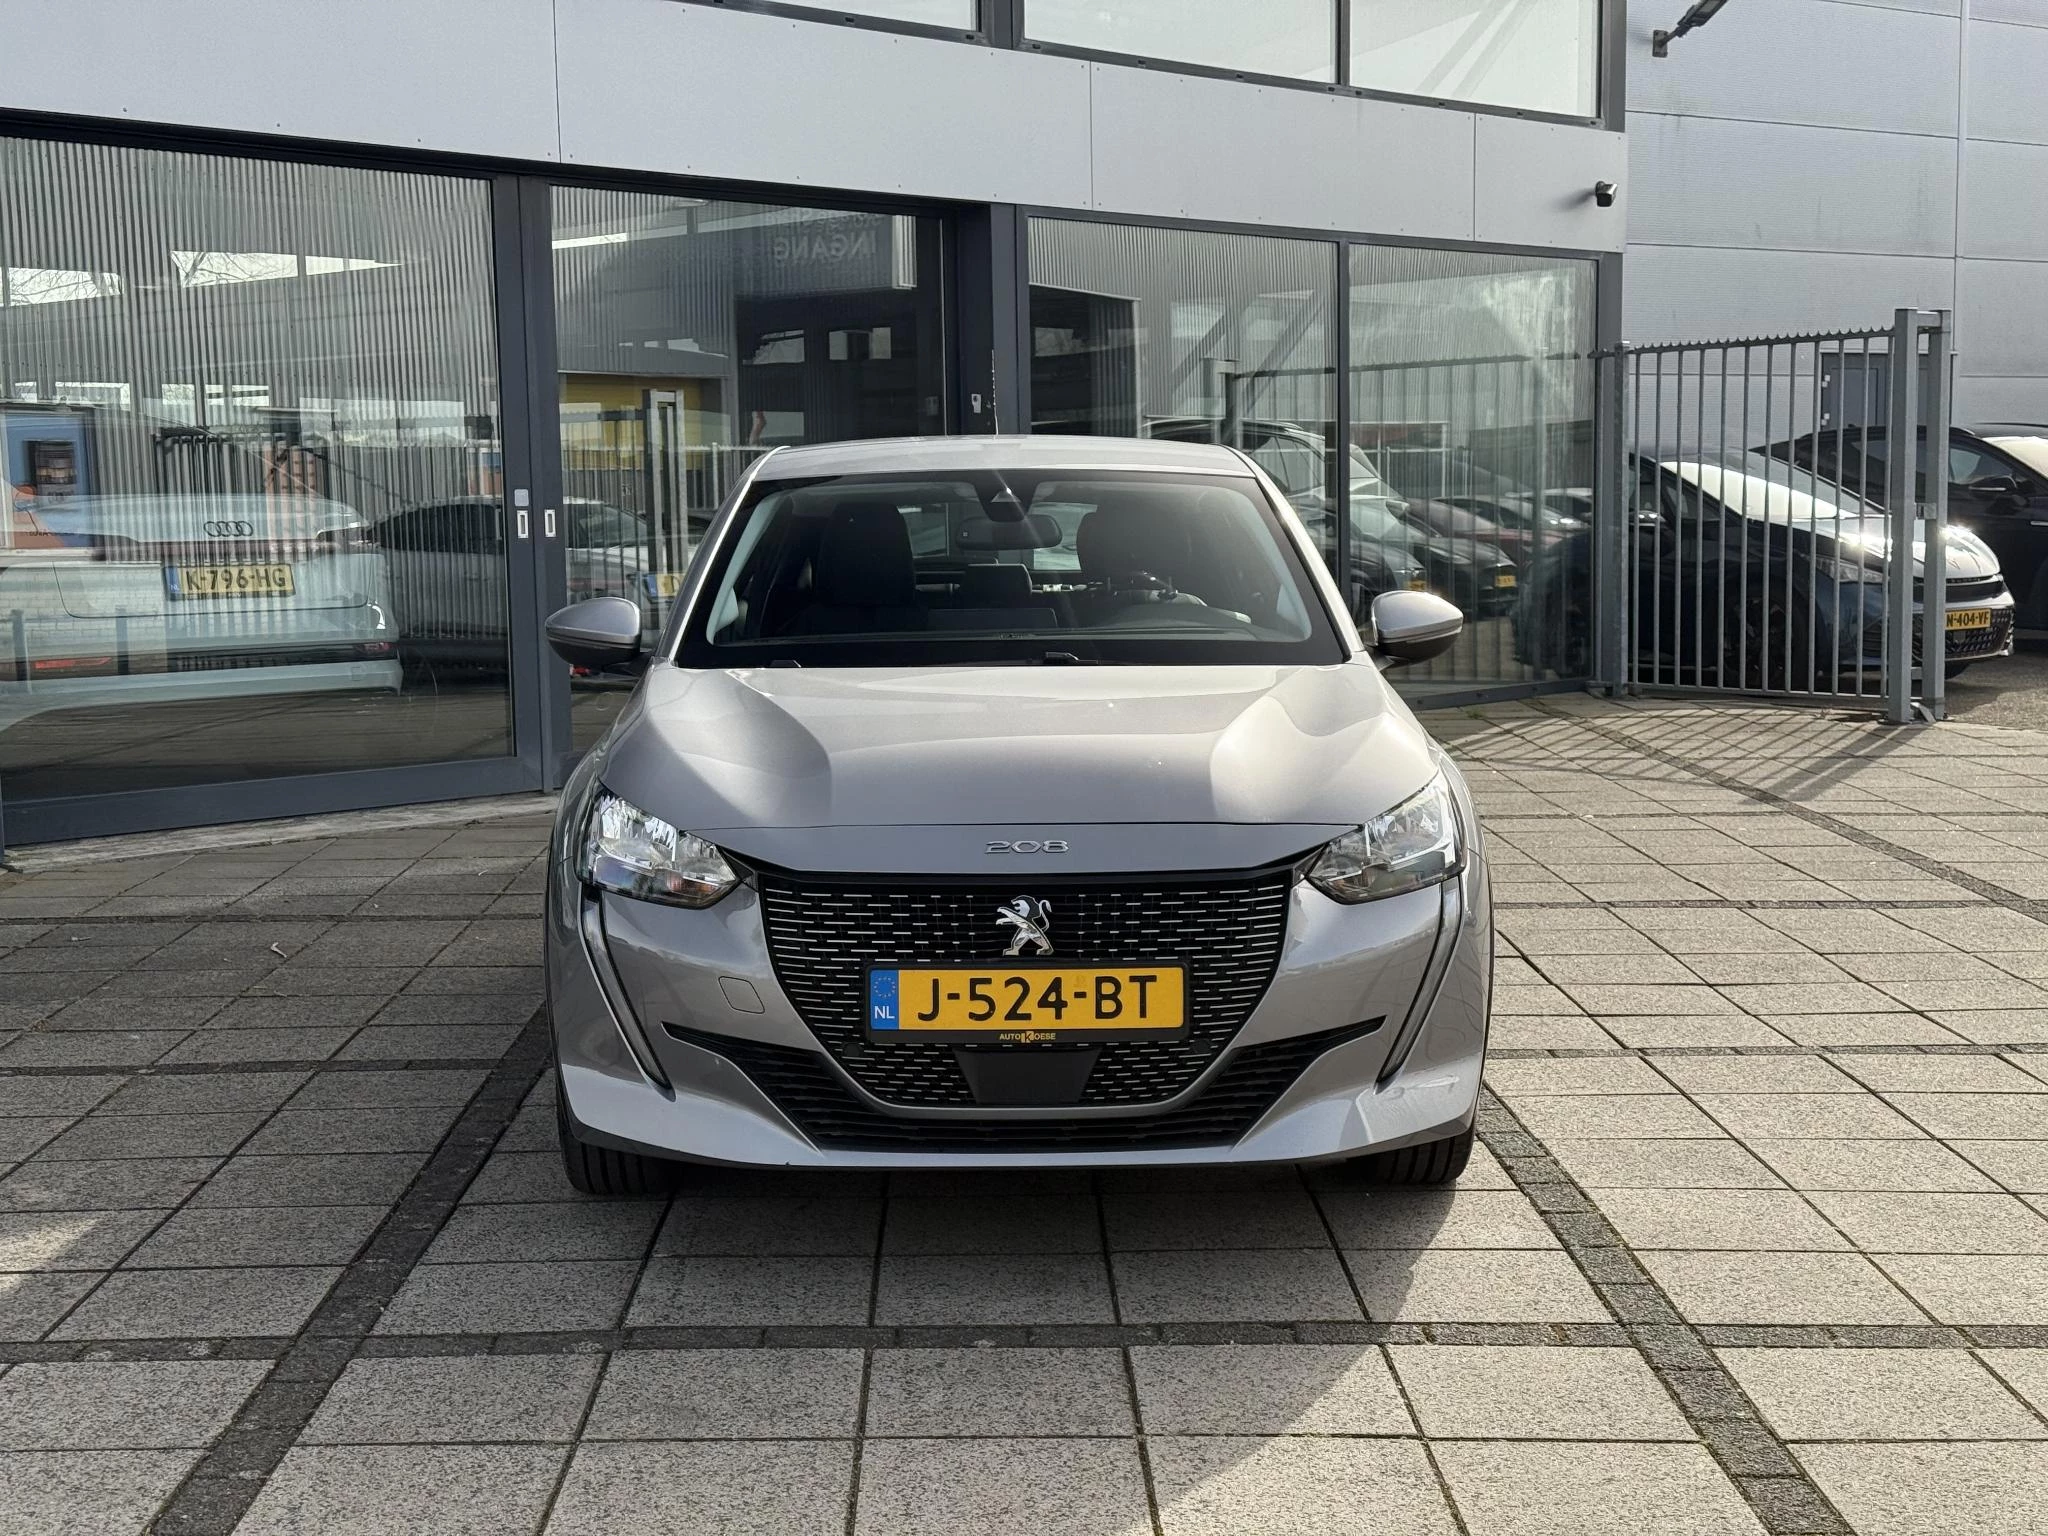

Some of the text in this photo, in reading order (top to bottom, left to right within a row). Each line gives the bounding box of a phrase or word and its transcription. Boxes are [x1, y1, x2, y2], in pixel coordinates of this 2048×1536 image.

[185, 567, 287, 591] K-796-HG
[984, 840, 1070, 854] 208
[917, 974, 1157, 1022] J-524-BT
[874, 1005, 895, 1019] NL
